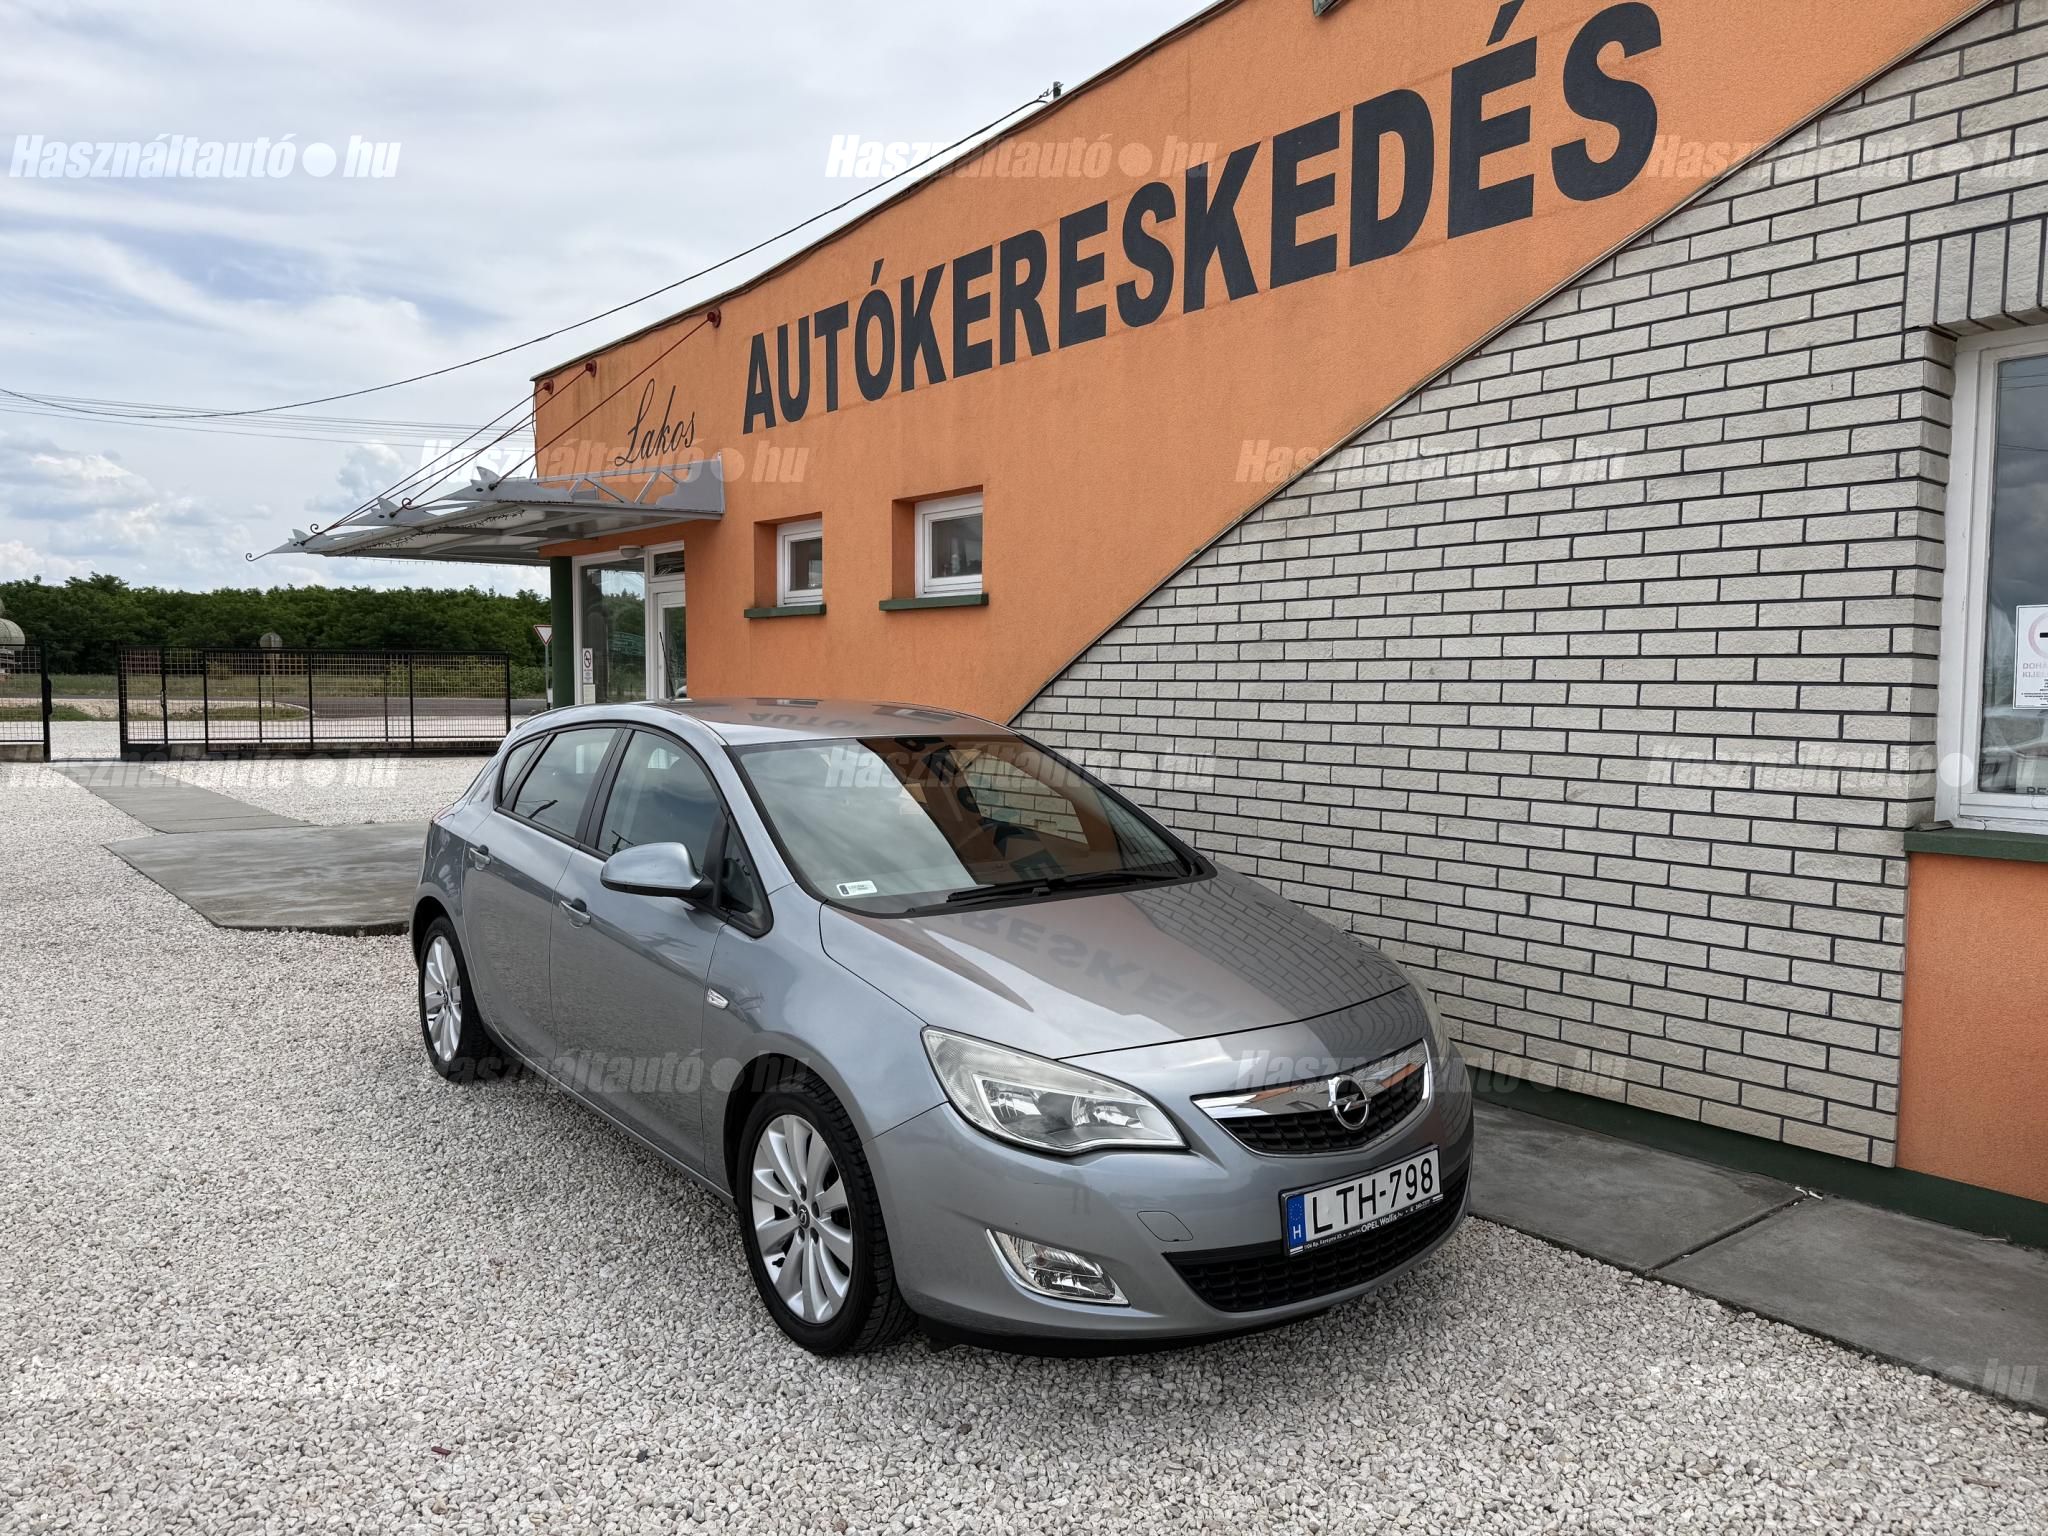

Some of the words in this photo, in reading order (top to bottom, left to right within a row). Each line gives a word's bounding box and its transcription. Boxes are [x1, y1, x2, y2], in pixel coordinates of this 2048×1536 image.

[743, 0, 1661, 435] AUTÓKERESKEDÉS
[615, 378, 695, 466] Lakos
[1293, 1224, 1302, 1240] H
[1313, 1158, 1433, 1234] LTH-798
